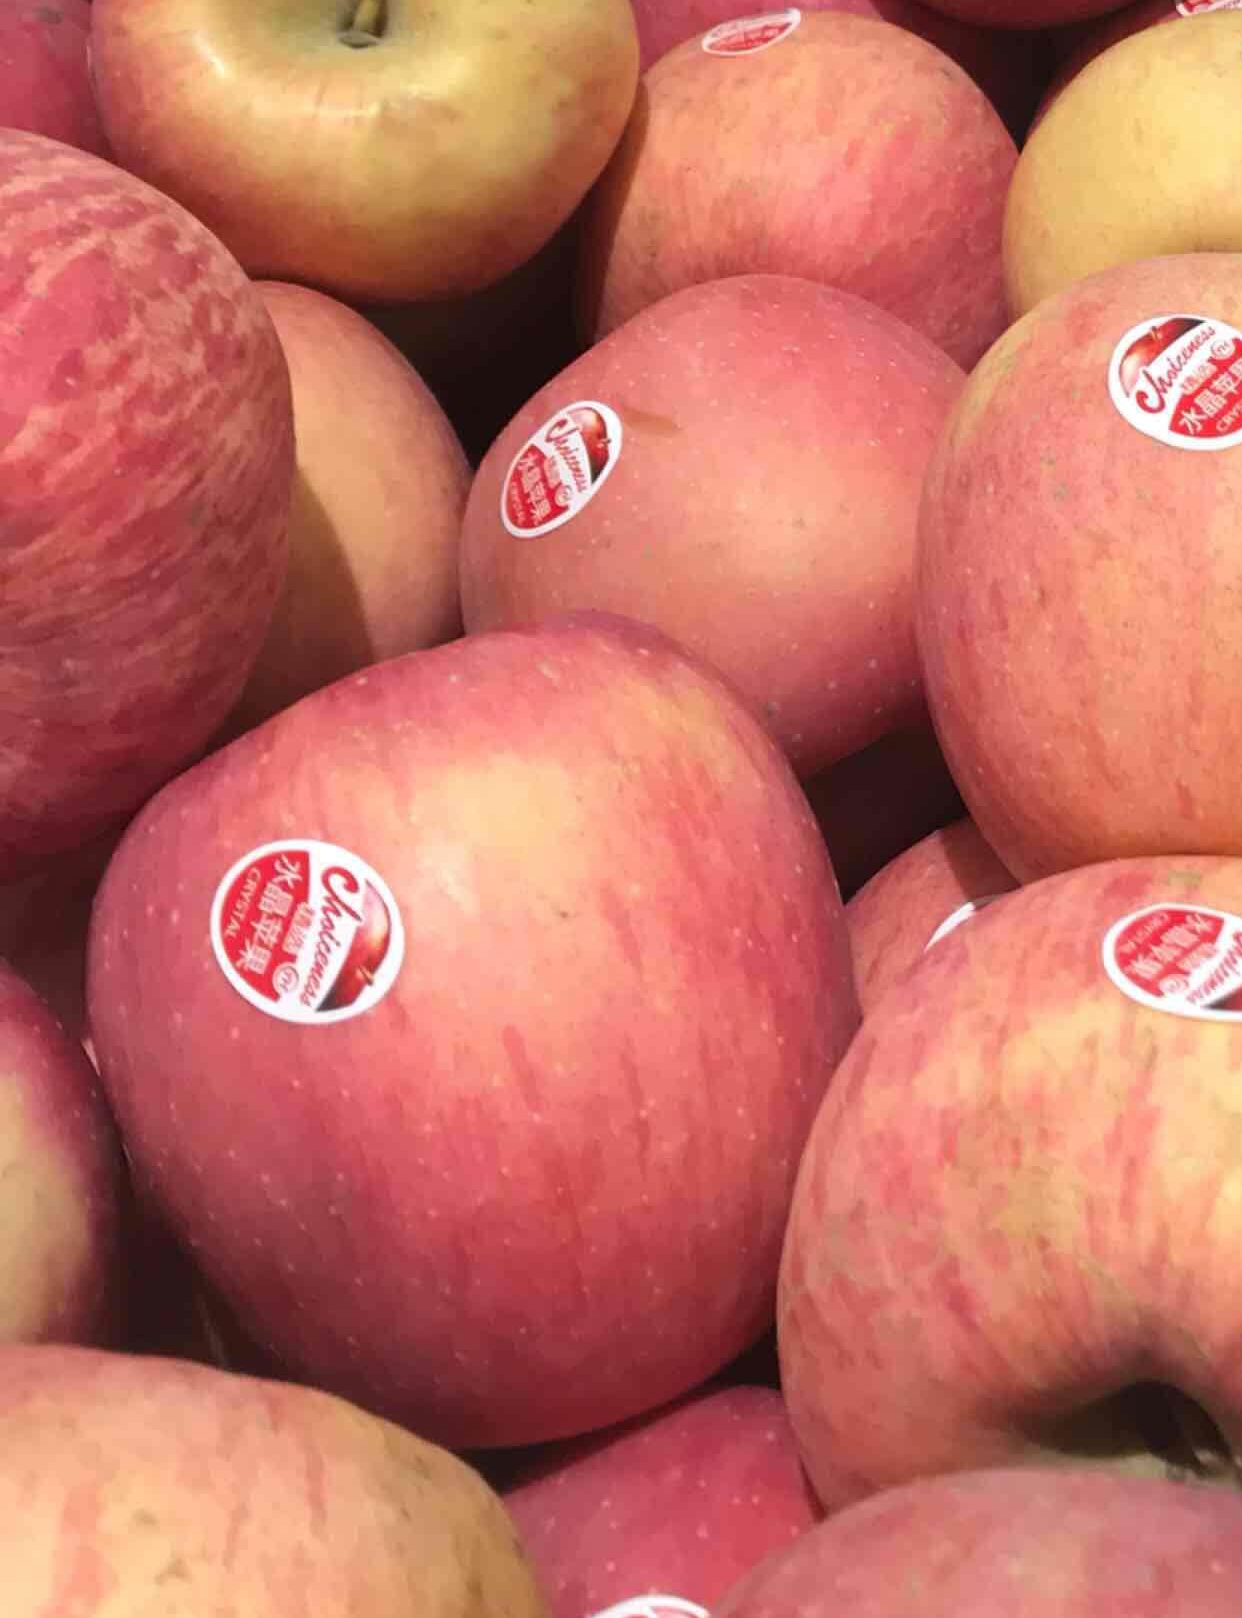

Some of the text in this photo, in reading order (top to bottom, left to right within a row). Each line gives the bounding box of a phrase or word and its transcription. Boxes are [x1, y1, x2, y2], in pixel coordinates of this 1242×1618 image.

[1136, 326, 1216, 414] Choiceness
[224, 867, 261, 938] CRYSTAL
[236, 854, 303, 974] 水晶苹果
[300, 866, 362, 1007] Choiceness
